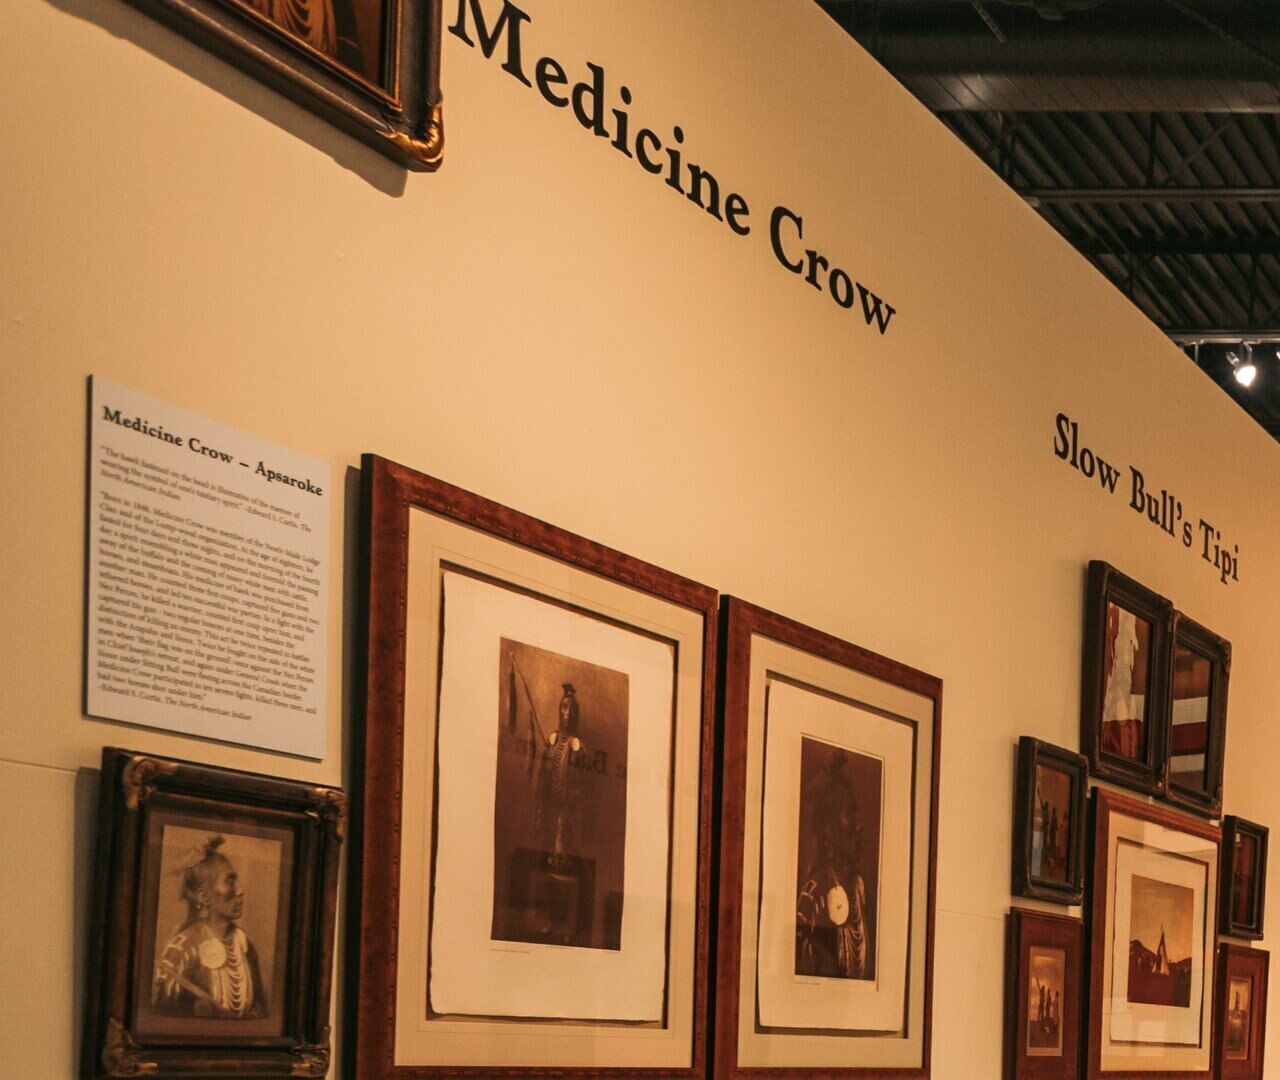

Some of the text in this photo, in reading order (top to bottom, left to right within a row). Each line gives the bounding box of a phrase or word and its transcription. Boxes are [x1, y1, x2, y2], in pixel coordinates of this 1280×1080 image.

[448, 0, 896, 335] Medicine Crow
[102, 406, 183, 447] Medicine
[188, 438, 233, 465] Crow
[255, 461, 323, 496] Apsaroke
[1054, 413, 1239, 584] Slow Bull's Tipi
